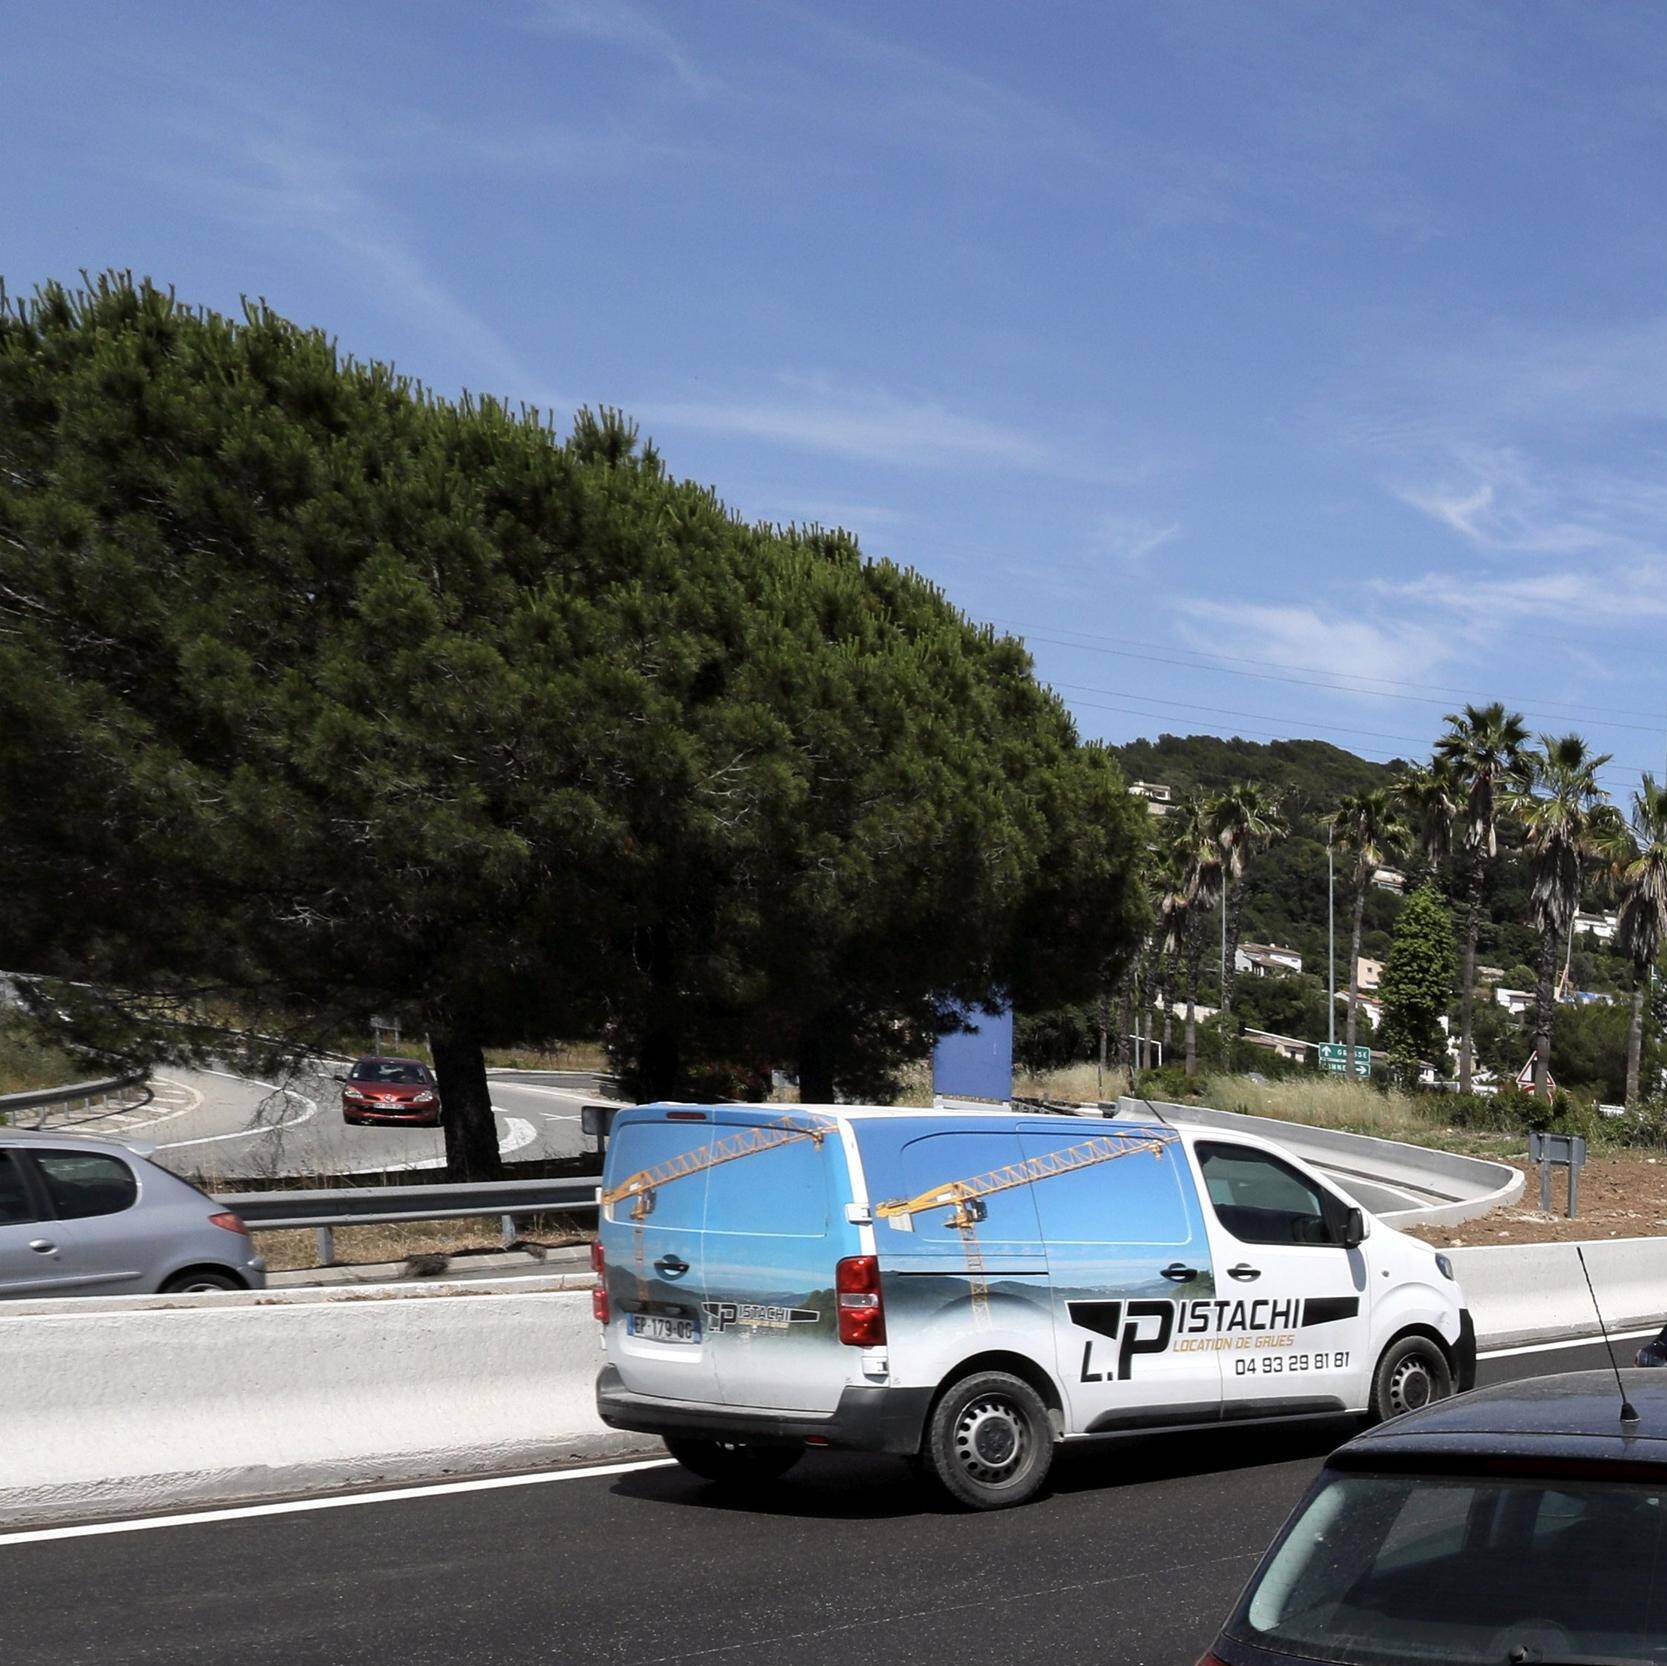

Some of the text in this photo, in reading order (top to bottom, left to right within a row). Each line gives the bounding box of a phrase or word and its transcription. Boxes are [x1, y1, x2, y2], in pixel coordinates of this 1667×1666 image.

[1173, 1335, 1295, 1352] LOCATION DE GRUES
[1235, 1352, 1350, 1376] 04 93 29 81 81
